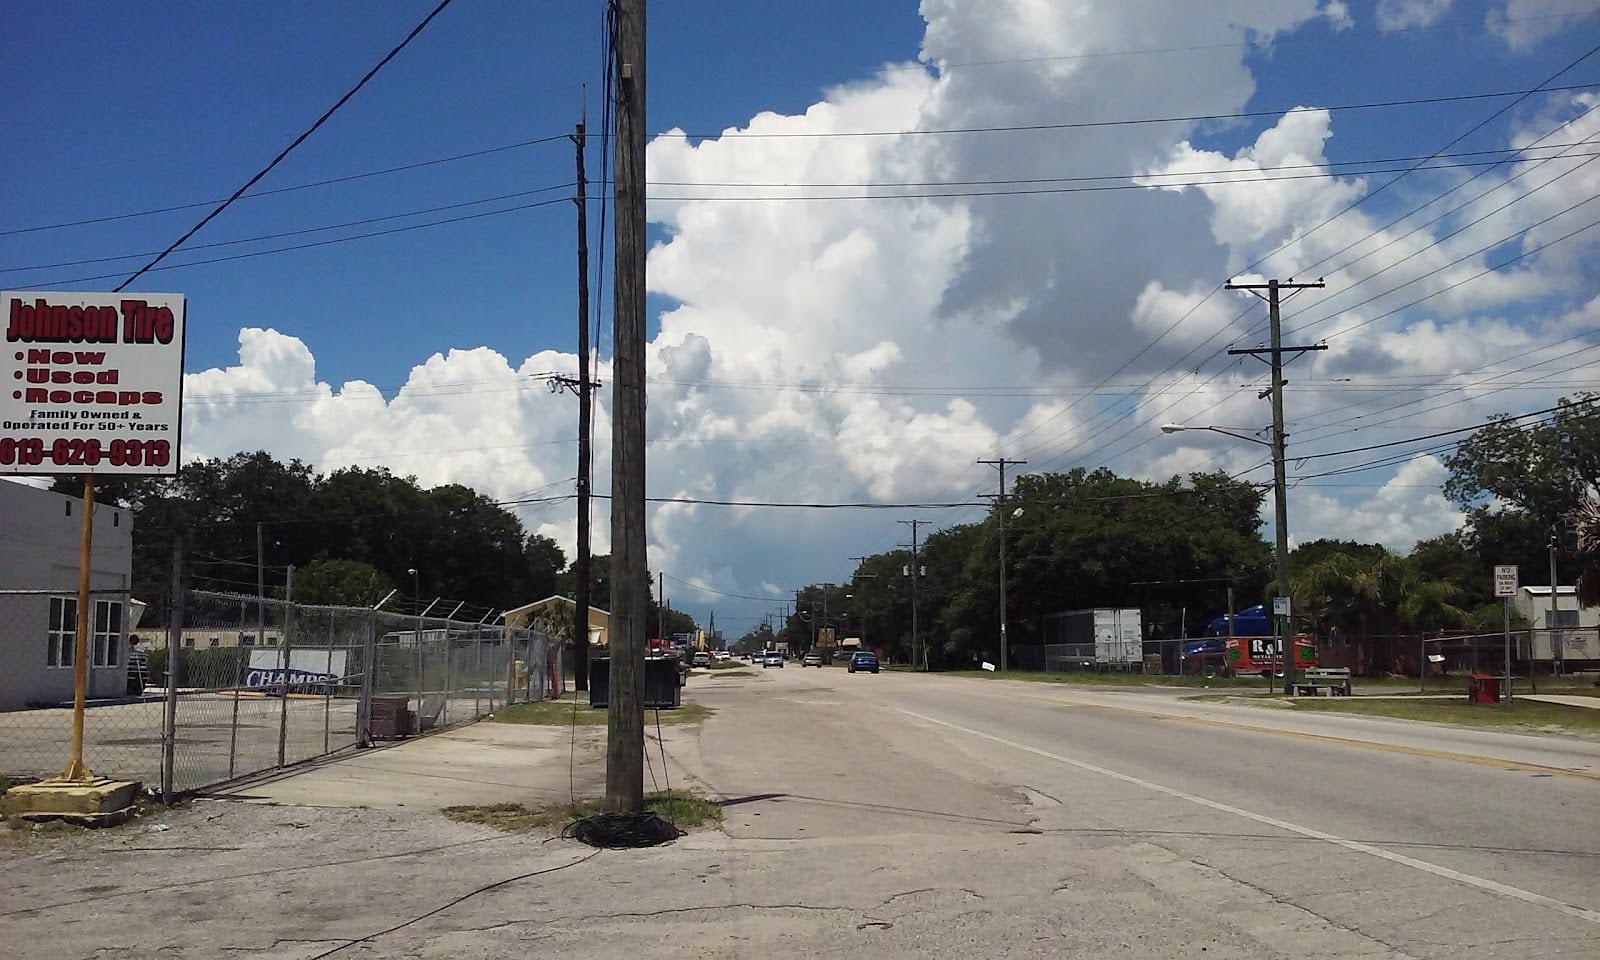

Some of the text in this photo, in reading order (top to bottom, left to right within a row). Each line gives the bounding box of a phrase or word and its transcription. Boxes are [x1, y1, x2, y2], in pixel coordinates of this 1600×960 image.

[6, 298, 174, 344] Johnson Tire
[27, 349, 106, 365] New
[26, 368, 119, 385] Used
[25, 387, 163, 406] Recaps
[30, 409, 142, 420] Family Owned &
[3, 421, 169, 431] Operated For 50+ Years
[0, 437, 170, 467] 813-626-9313
